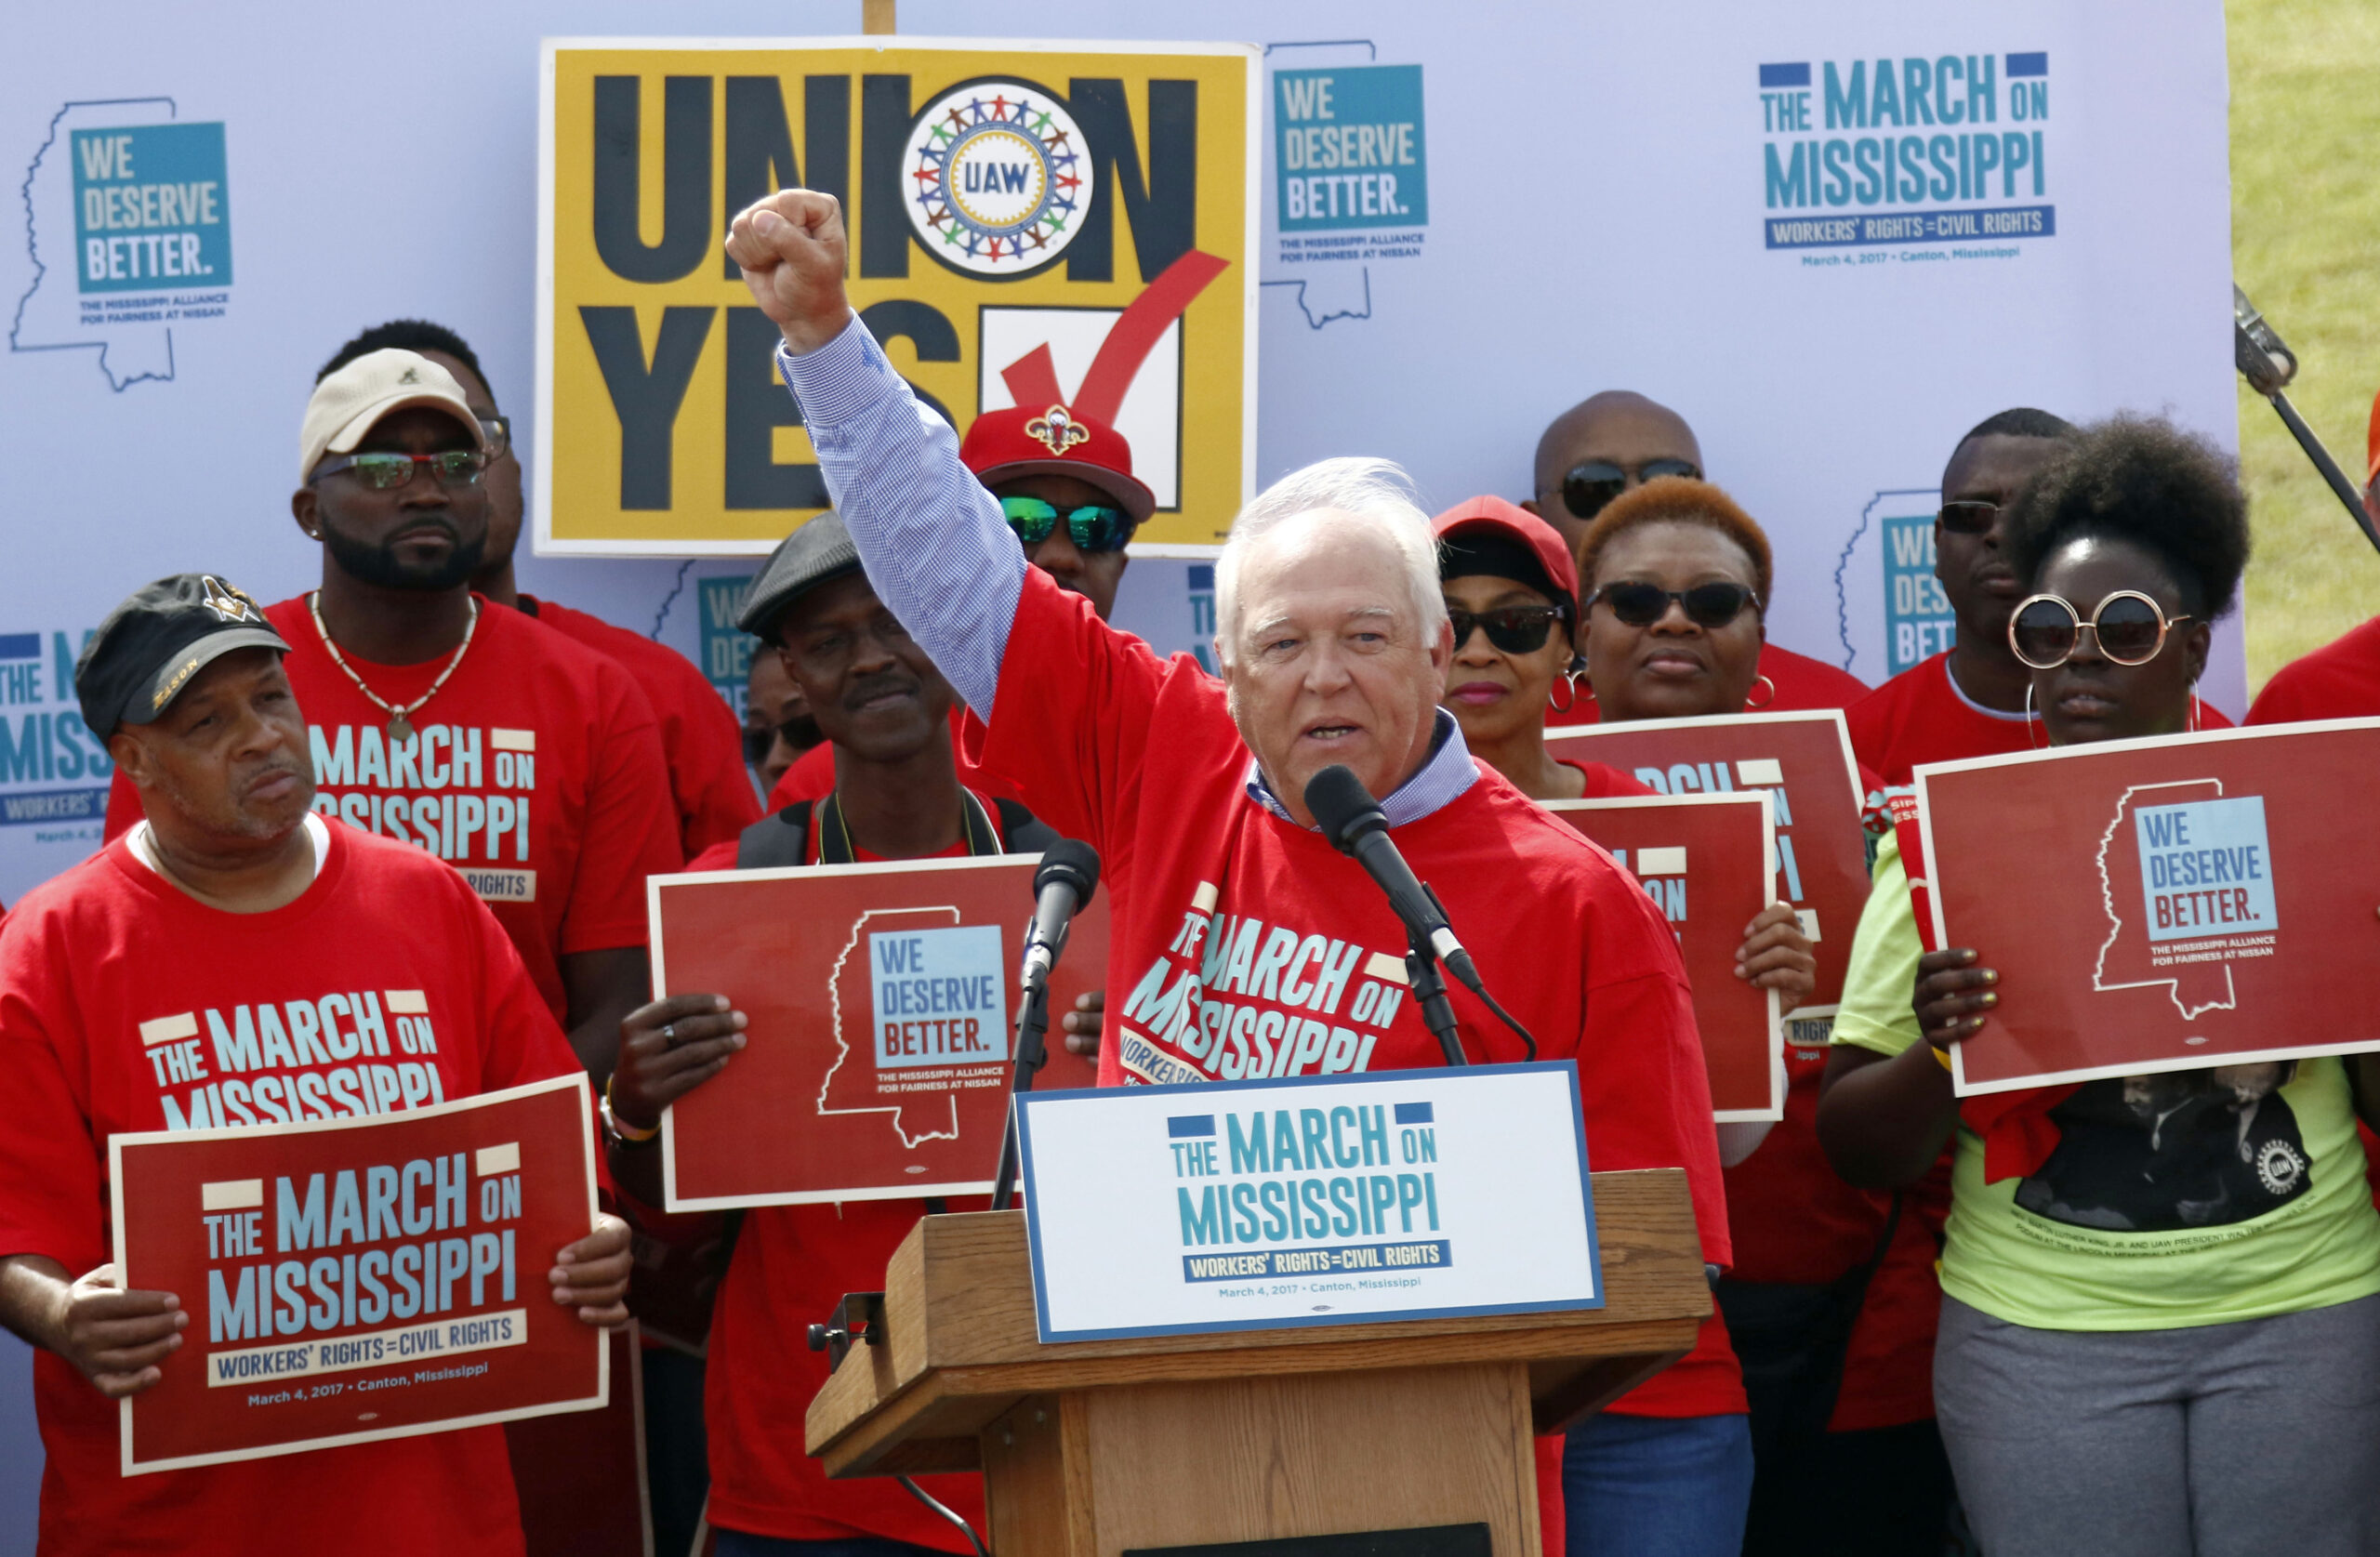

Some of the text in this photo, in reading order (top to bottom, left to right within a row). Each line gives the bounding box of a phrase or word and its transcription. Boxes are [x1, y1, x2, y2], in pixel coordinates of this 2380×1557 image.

[1282, 77, 1334, 121] WE
[1760, 54, 2048, 133] THE MARCH ON
[80, 136, 134, 180] WE
[1286, 123, 1416, 170] DESERVE
[593, 73, 1198, 284] UNION
[965, 161, 1030, 194] UAW
[1765, 130, 2045, 209] MISSISSIPPI
[84, 182, 218, 231] DESERVE
[1287, 173, 1409, 219] BETTER.
[1280, 233, 1424, 249] THE MISSISSIPPI ALLIANCE
[1773, 218, 1860, 244] WORKERS'
[1983, 210, 2043, 233] RIGHTS
[86, 232, 213, 281] BETTER.
[1280, 247, 1421, 263] FOR FAIRNESS AT NISSAN
[1802, 245, 2020, 267] March 4, 2017 Canton, Mississippi
[80, 294, 229, 310] THE MISSISSIPPI ALLIANCE
[81, 308, 225, 325] FOR FAIRNESS AT NISSAN
[308, 724, 536, 790] MARCH ON
[2143, 811, 2190, 849] WE
[2149, 845, 2263, 890] DESERVE
[2154, 887, 2261, 930] BETTER.
[879, 938, 923, 974] WE
[2150, 935, 2277, 956] THE MISSISSIPPI ALLIANCE
[2152, 946, 2274, 967] FOR FAIRNESS AT NISSAN
[1201, 912, 1364, 1014] MARCH
[1351, 981, 1404, 1029] ON
[883, 975, 996, 1016] DESERVE
[145, 990, 438, 1088] THE MARCH ON
[884, 1018, 991, 1057] BETTER.
[1792, 1020, 1833, 1041] RIGH
[878, 1066, 1004, 1082] THE MISSISSIPPI ALLIANCE
[878, 1077, 1001, 1093] FOR FAIRNESS AT NISSAN
[1170, 1104, 1438, 1178] THE MARCH ON
[2269, 1159, 2293, 1177] UAW
[203, 1152, 522, 1260] THE MARCH ON
[1177, 1171, 1440, 1247] MISSISSIPPI
[1189, 1252, 1271, 1279] WORKERS'
[1384, 1244, 1441, 1266] RIGHTS
[2129, 1241, 2149, 1249] AND
[2151, 1239, 2172, 1248] UAW
[2175, 1233, 2225, 1247] PRESIDENT
[207, 1228, 517, 1343] MISSISSIPPI
[1219, 1276, 1421, 1299] March 4, 2017 Canton, Mississippi
[218, 1343, 314, 1379] WORKERS'
[450, 1316, 512, 1348] RIGHTS
[247, 1361, 489, 1407] March 4, 2017 Canton, Mississippi
